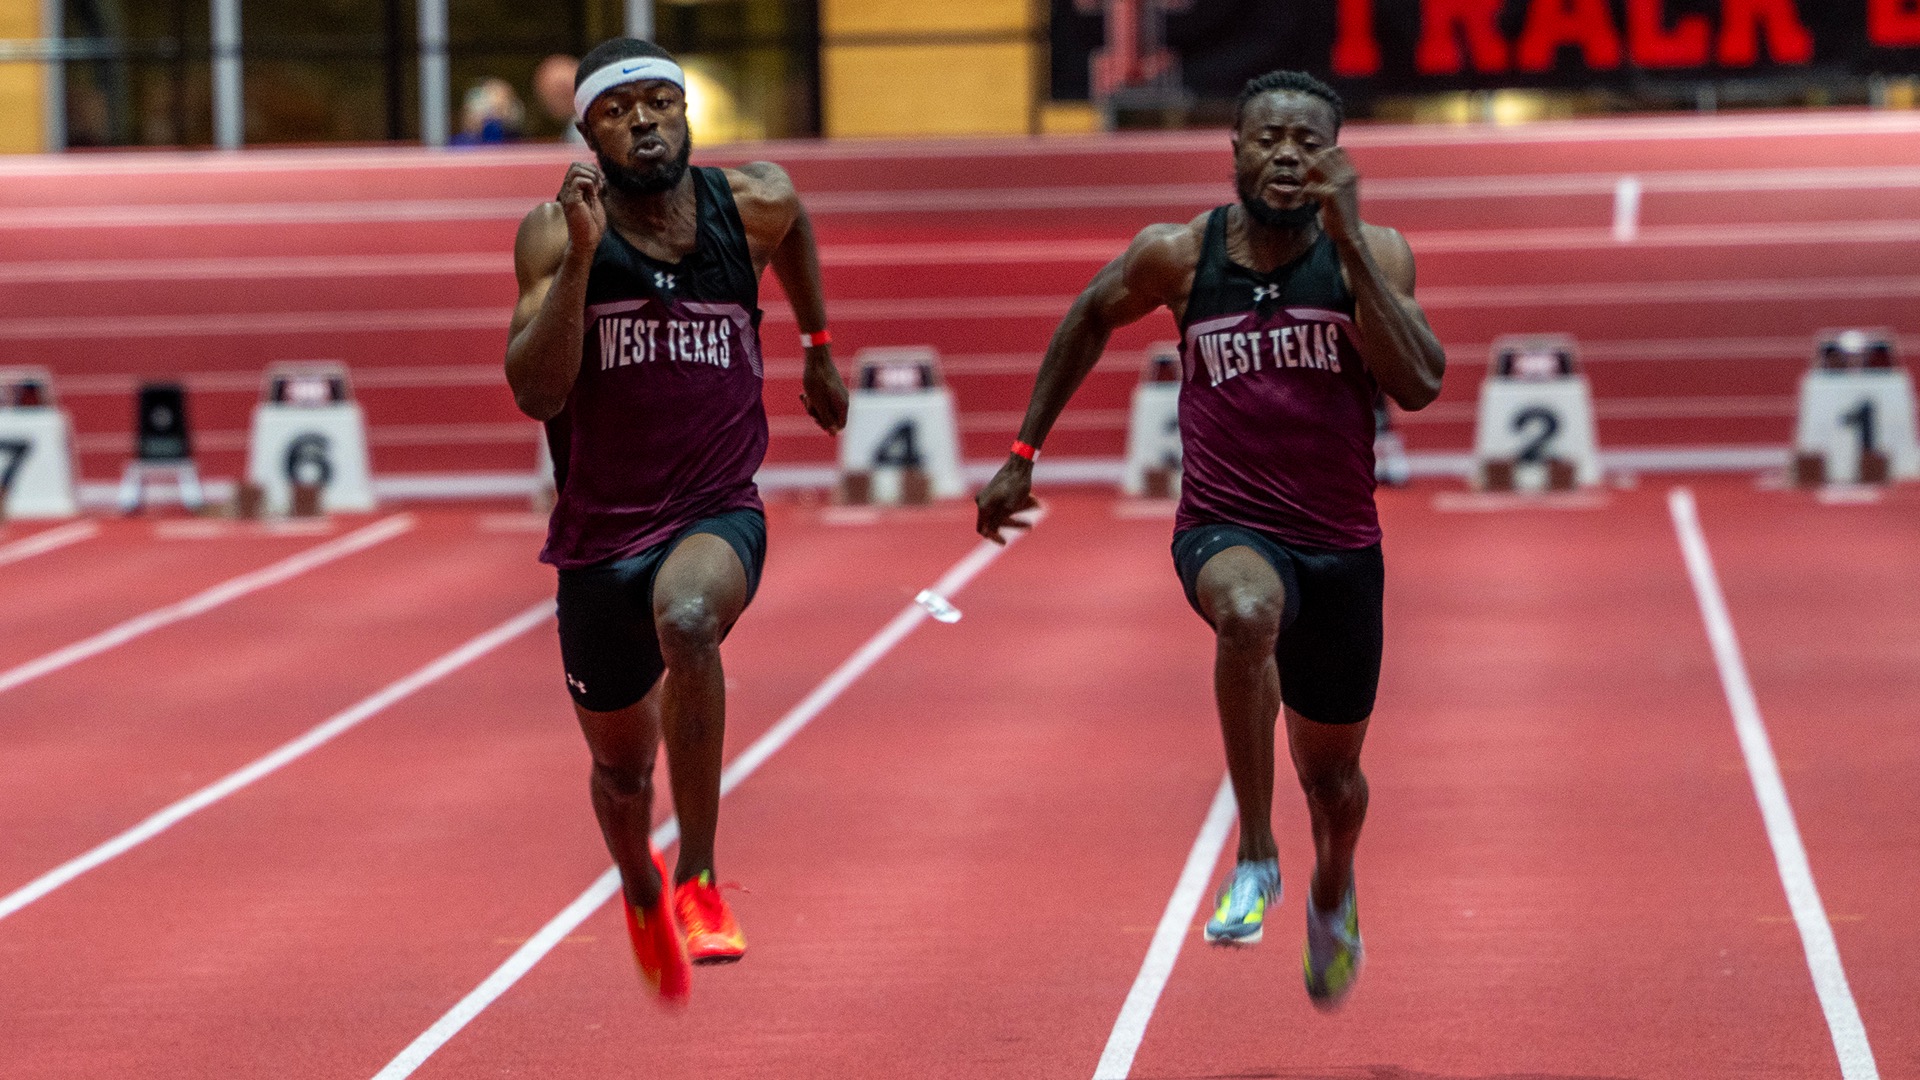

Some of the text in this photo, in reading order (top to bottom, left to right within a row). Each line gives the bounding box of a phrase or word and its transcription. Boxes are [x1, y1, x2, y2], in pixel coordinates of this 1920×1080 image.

[599, 317, 731, 371] WEST TEXAS
[1199, 323, 1342, 387] WEST TEXAS
[873, 418, 926, 470] 4
[1509, 406, 1562, 463] 2
[1839, 396, 1876, 454] 1
[284, 432, 333, 490] 6
